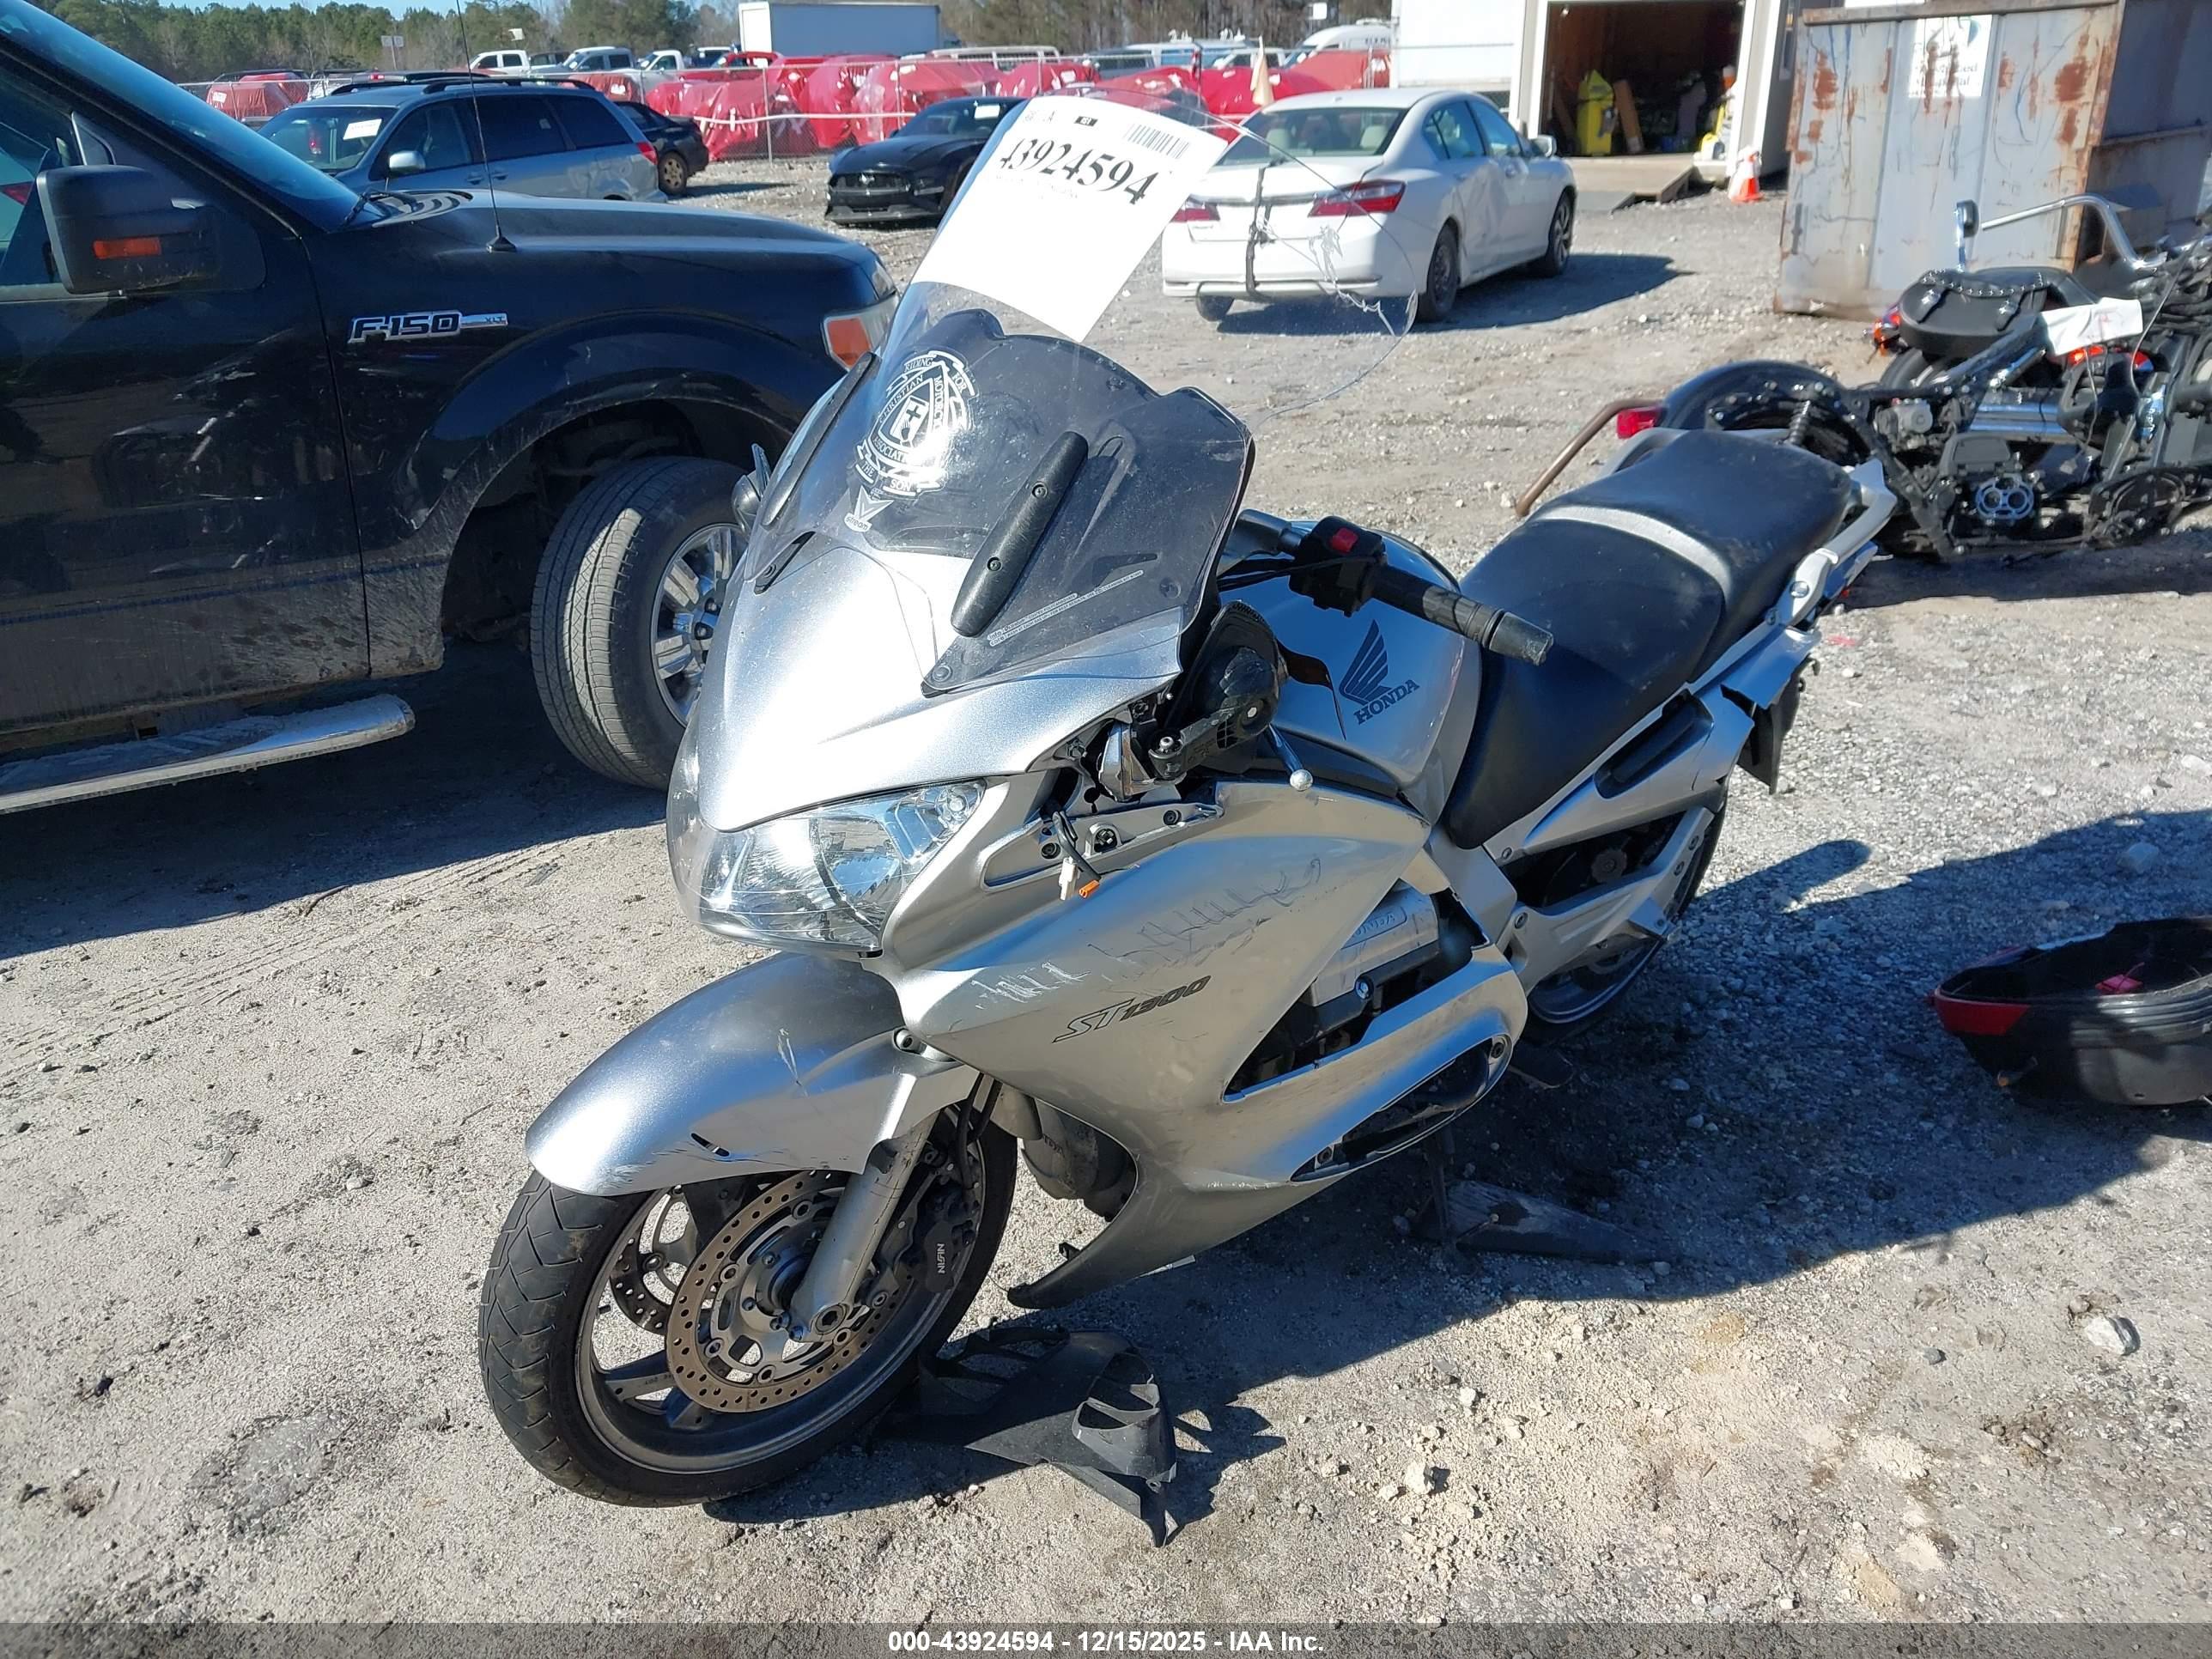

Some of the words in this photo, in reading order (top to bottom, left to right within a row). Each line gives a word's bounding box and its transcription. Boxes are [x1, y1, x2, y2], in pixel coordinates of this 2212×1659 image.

[1000, 138, 1159, 205] 43924594
[353, 312, 461, 340] F-150
[904, 356, 933, 372] RIDING
[952, 371, 967, 394] FOR
[879, 374, 924, 423] CHRISTIAN
[861, 460, 875, 477] THE
[889, 478, 911, 493] SON
[1352, 679, 1420, 725] HONDA
[1052, 975, 1212, 1043] ST1300
